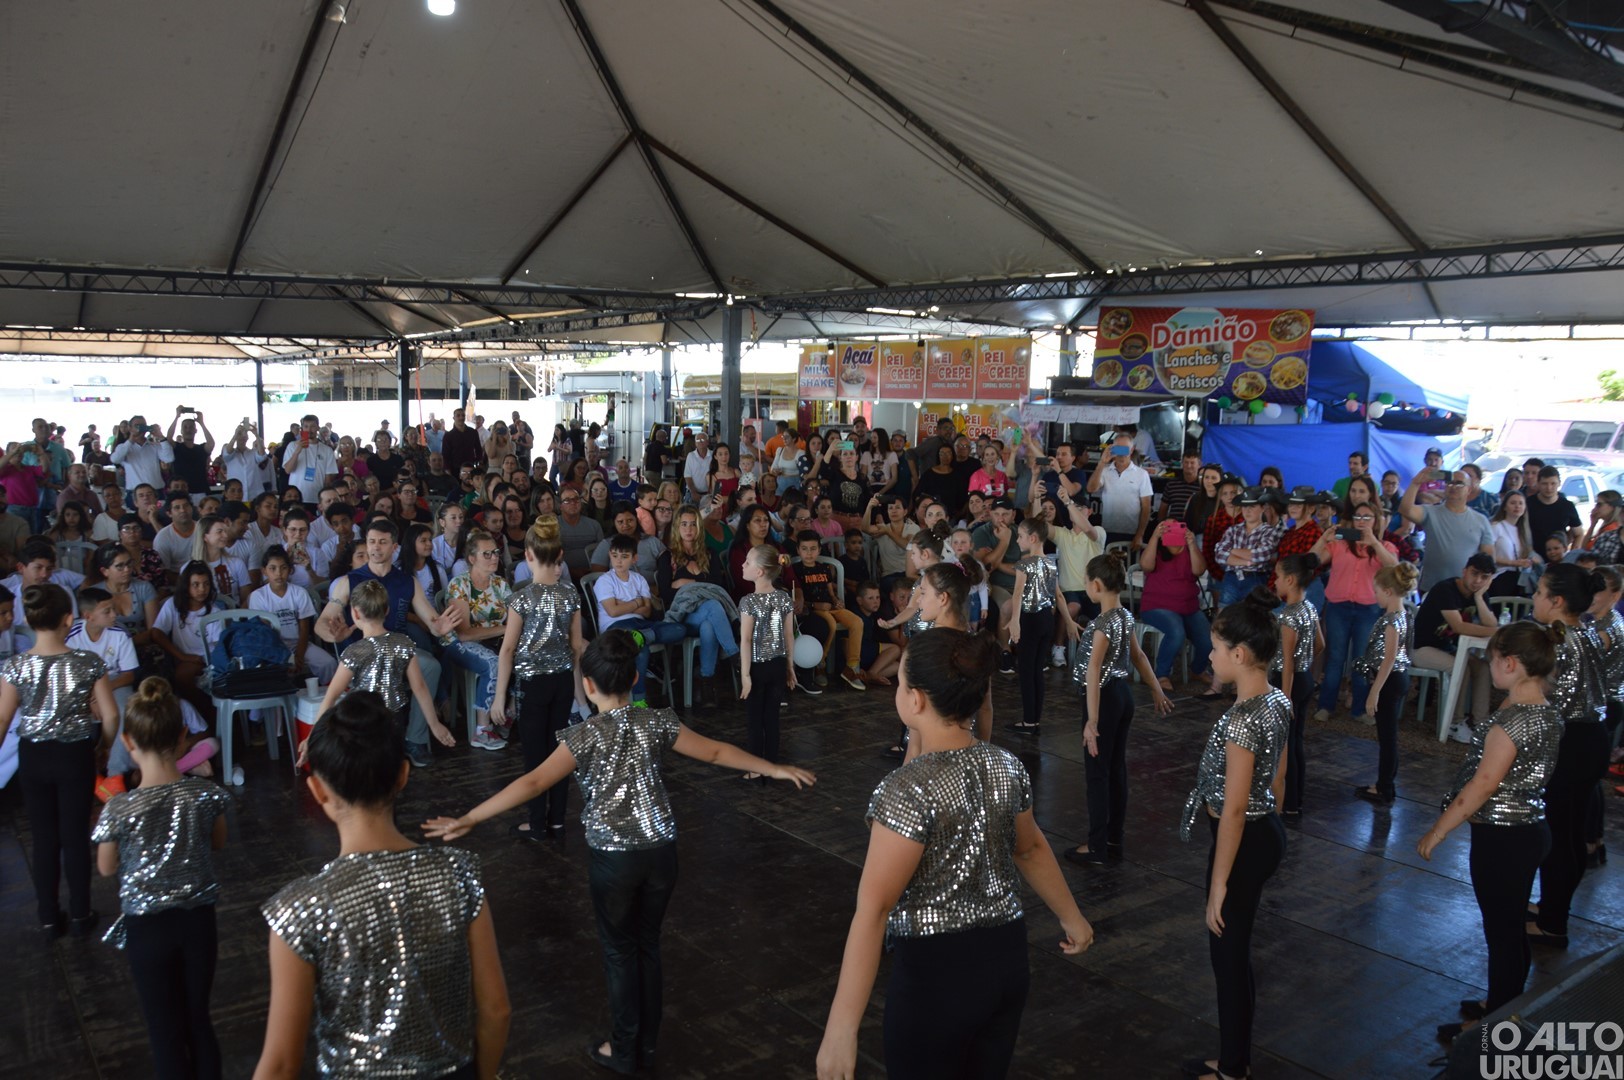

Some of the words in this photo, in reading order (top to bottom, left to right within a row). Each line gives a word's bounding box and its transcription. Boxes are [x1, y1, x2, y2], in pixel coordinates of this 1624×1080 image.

[1153, 315, 1255, 348] Damião
[842, 346, 877, 369] Açaí
[886, 355, 903, 366] REI
[933, 352, 952, 364] REI
[984, 351, 1004, 363] REI
[1164, 351, 1218, 368] Lanches
[1222, 354, 1231, 365] e
[804, 365, 830, 375] MILK
[891, 367, 922, 380] CREPE
[938, 366, 972, 379] CREPE
[989, 365, 1025, 379] CREPE
[800, 377, 835, 388] SHAKE
[1171, 375, 1224, 389] Petiscos
[923, 413, 938, 423] REI
[965, 415, 980, 425] REI
[968, 426, 998, 438] CREPE
